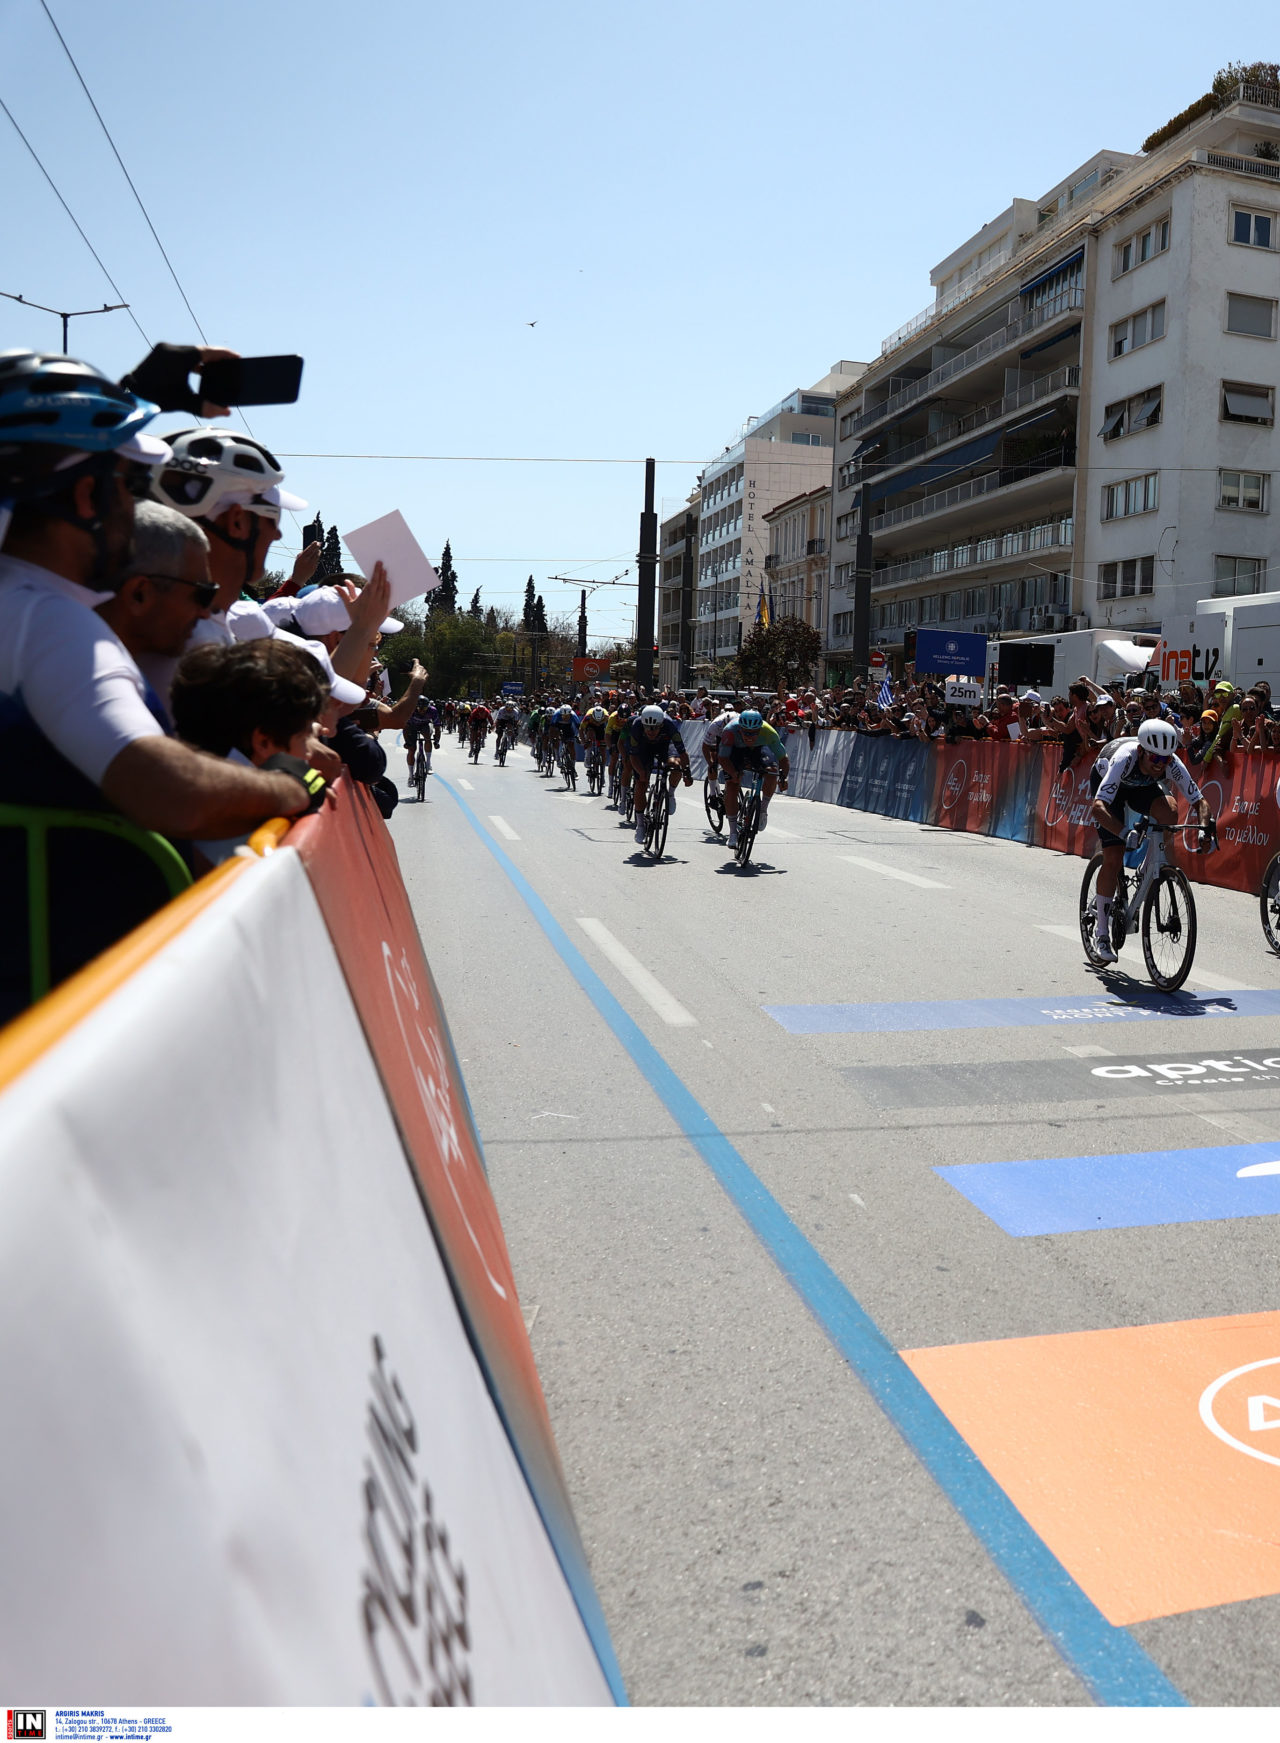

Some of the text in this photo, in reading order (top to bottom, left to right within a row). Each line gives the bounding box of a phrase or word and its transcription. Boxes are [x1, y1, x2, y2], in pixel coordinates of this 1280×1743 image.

[744, 480, 757, 611] HOTEL AMALIA
[950, 686, 976, 699] 25m
[947, 772, 961, 797] ΔΕΗ
[1052, 782, 1069, 811] ΔΕΗ
[1225, 825, 1270, 846] το μέλλον
